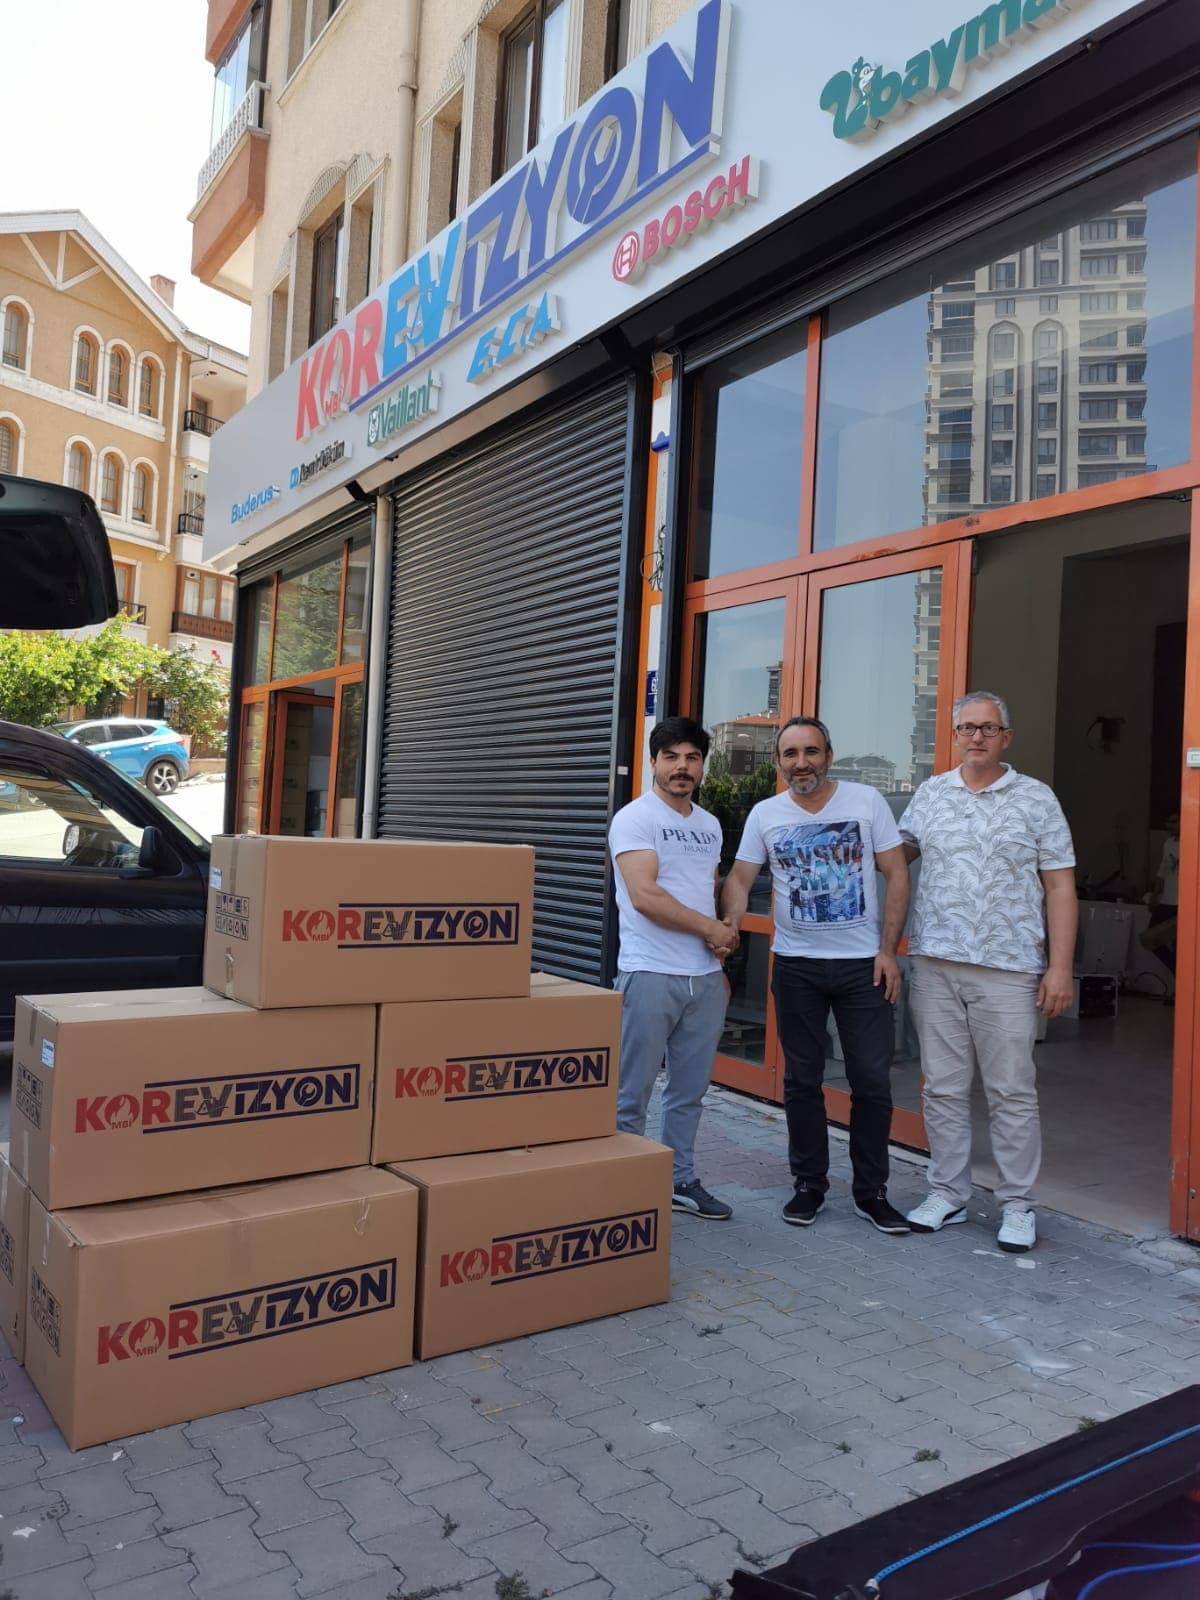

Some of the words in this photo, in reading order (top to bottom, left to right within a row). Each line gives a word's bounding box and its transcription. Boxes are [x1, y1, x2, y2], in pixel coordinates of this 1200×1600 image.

[642, 154, 750, 263] BOSCH
[379, 367, 433, 439] Vaillant
[231, 484, 274, 525] Buderus
